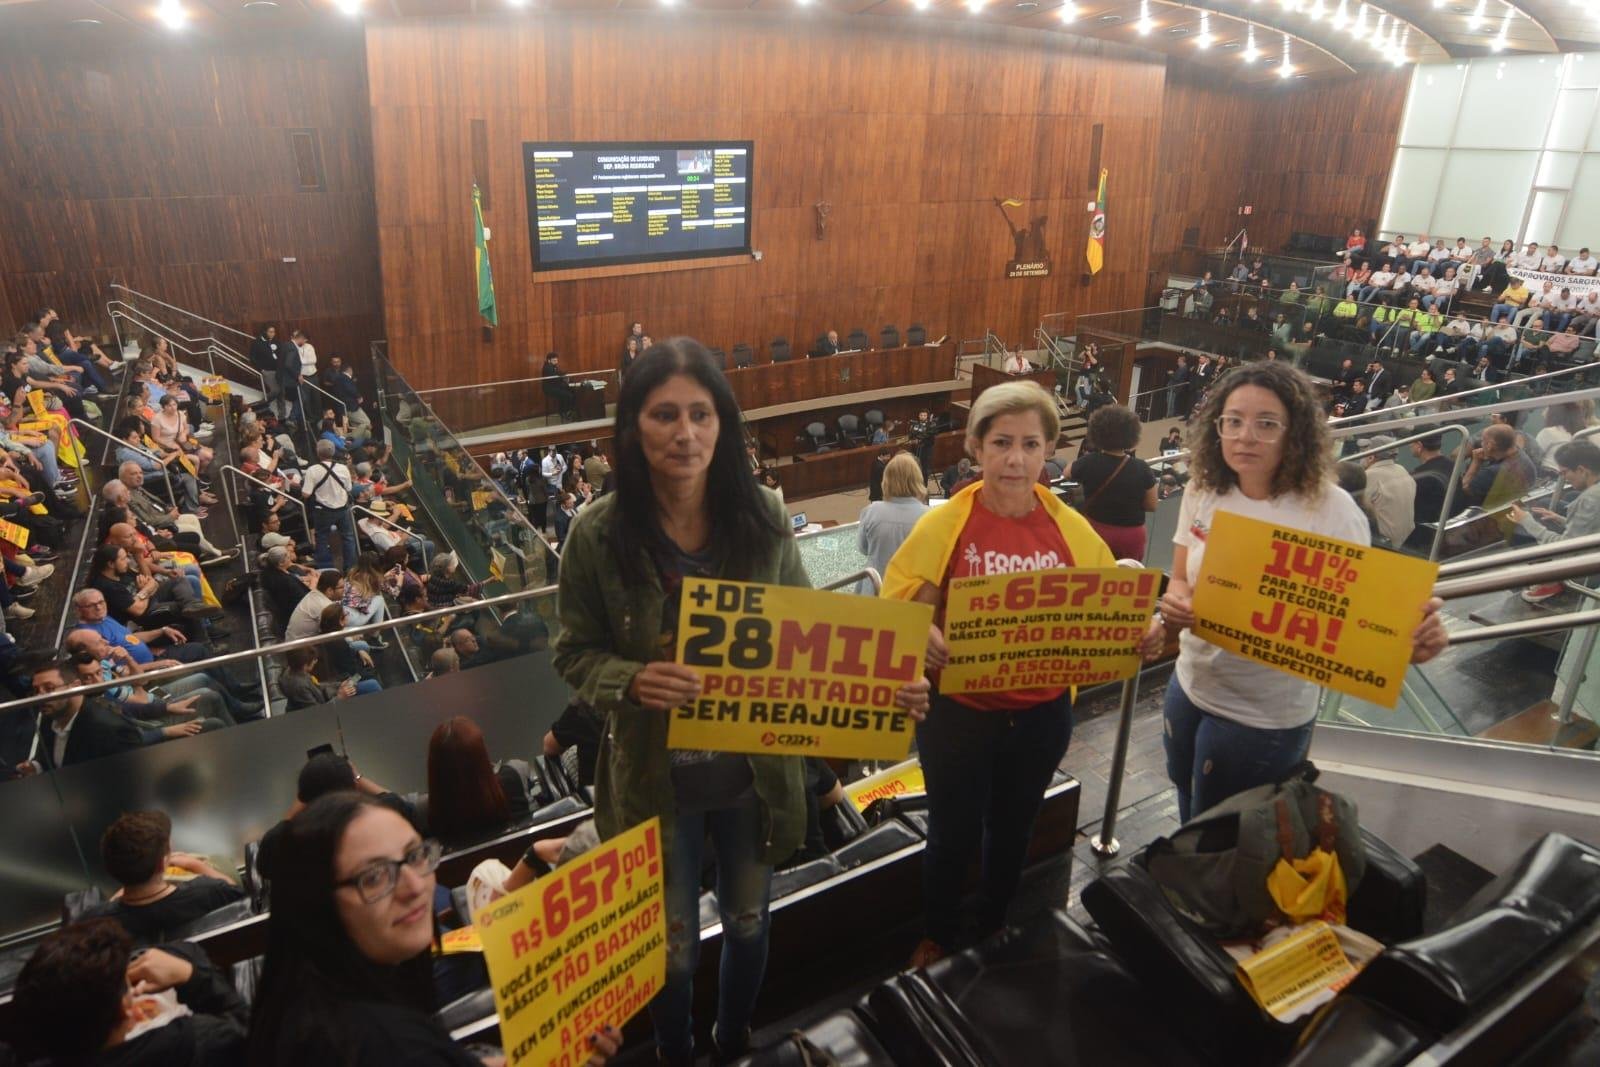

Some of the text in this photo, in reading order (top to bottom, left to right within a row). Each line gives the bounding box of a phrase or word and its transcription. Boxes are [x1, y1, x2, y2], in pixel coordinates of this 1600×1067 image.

[1272, 530, 1365, 560] REAJUSTE DE
[1258, 585, 1348, 619] CATEGORIA
[1262, 574, 1350, 606] PARA TODA A
[949, 624, 1143, 644] BÁSICO TÃO BAIXO?
[950, 611, 1147, 630] VOCÊ ACHA JUSTO UM SALÁRIO
[683, 613, 917, 682] 28 MIL
[949, 656, 976, 665] SEM
[979, 654, 996, 663] OS
[1200, 618, 1386, 688] EXIGIMOS VALORIZAÇÃO
[1240, 644, 1332, 683] E RESPEITO!
[965, 670, 1120, 690] NÃO FUNCIONA!
[998, 659, 1091, 675] A ESCOLA
[703, 674, 908, 708] POSENTADO
[677, 699, 907, 732] SEM REAJUSTE
[501, 882, 659, 999] VOCÊ ACHA JUSTO UM SALÁRIO
[504, 901, 660, 1020] BÁSICO TÃO BAIXO?
[561, 974, 634, 1049] A ESCOLA
[574, 976, 656, 1064] FCIONA!
[512, 1031, 538, 1065] SEM
[539, 1017, 556, 1039] OS
